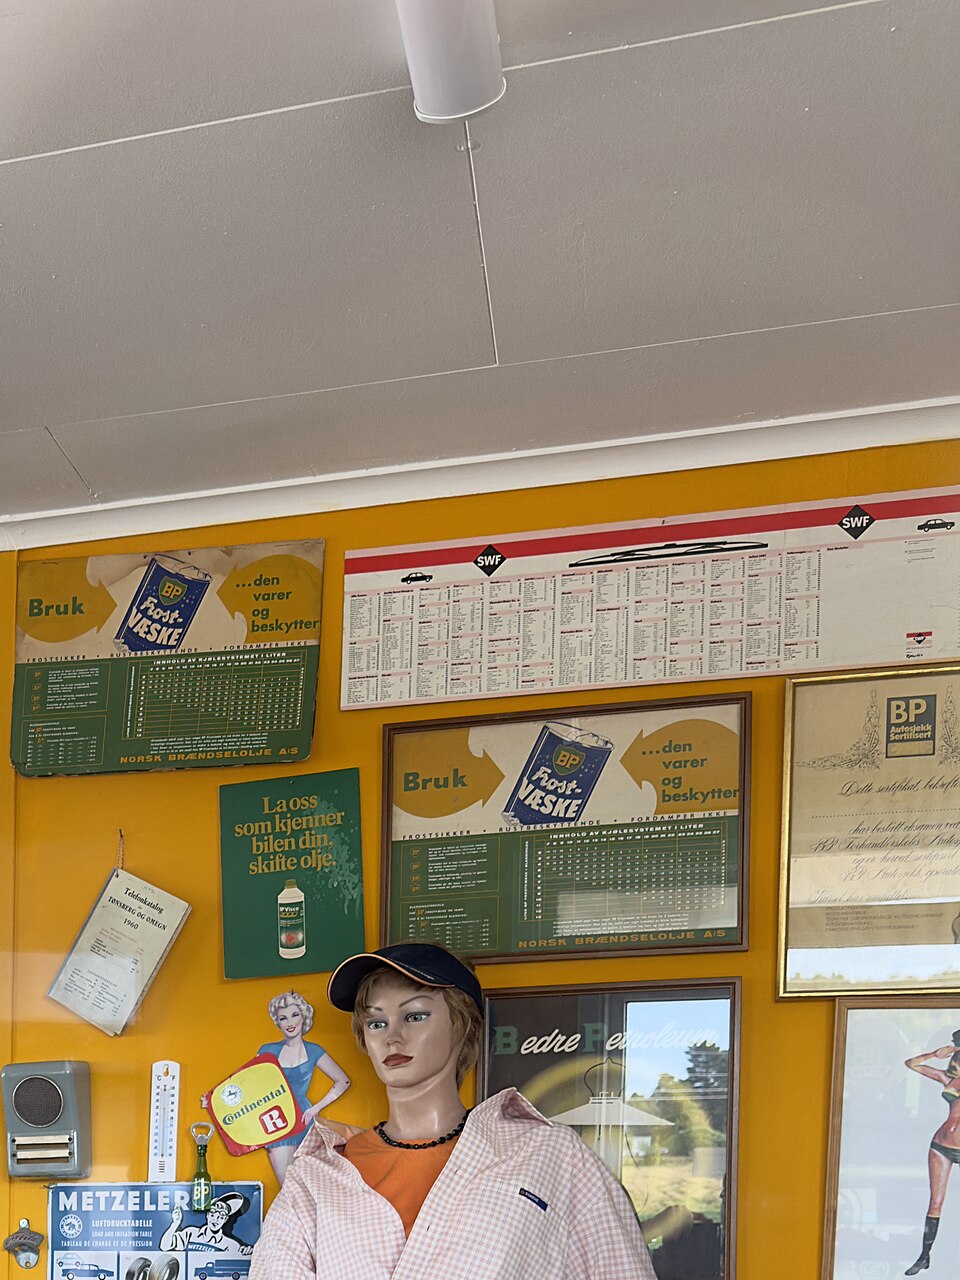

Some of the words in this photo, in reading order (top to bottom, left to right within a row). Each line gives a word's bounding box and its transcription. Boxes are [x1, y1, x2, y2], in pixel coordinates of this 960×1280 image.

[842, 515, 870, 529] SWF
[477, 555, 502, 568] SWF
[161, 581, 182, 598] BP
[253, 589, 292, 602] varer
[28, 597, 85, 618] Bruk
[140, 597, 183, 625] Frost-
[252, 606, 269, 620] og
[127, 609, 182, 647] VÆSKE
[251, 618, 320, 633] beskytter
[890, 699, 927, 725] BP
[889, 730, 931, 741] Sertifisert
[890, 723, 932, 734] Autosjekk
[120, 755, 162, 764] NORSK
[168, 749, 272, 761] BRÆNDSELOLJE
[557, 751, 580, 768] BP
[662, 757, 708, 770] varer
[403, 768, 468, 792] Bruk
[531, 766, 582, 795] Frost-
[661, 775, 682, 789] og
[838, 780, 874, 797] Dette
[518, 777, 583, 819] VÆSKE
[661, 787, 739, 805] beskytter
[262, 797, 287, 815] La
[289, 795, 318, 810] oss
[234, 821, 272, 837] som
[274, 811, 345, 836] kjenner
[631, 813, 695, 822] FORDAMPER
[251, 834, 296, 855] bilen
[298, 830, 334, 850] din,
[402, 830, 471, 840] FROSTSIKKER
[249, 855, 297, 875] skifte
[300, 851, 337, 872] olje.
[123, 887, 164, 915] Telefonkatalog
[107, 895, 137, 917] TØNSBERG
[145, 915, 168, 931] OMEGN
[123, 918, 139, 930] 1960
[518, 938, 567, 948] NORSK
[575, 931, 696, 945] BRÆNDSELOLJE
[494, 1025, 581, 1056] Bedre
[222, 1084, 287, 1126] Continental
[261, 1109, 288, 1134] R
[193, 1185, 209, 1200] BP
[59, 1191, 190, 1212] METZELER
[92, 1219, 153, 1228] LUFTDRUCKTABELLE
